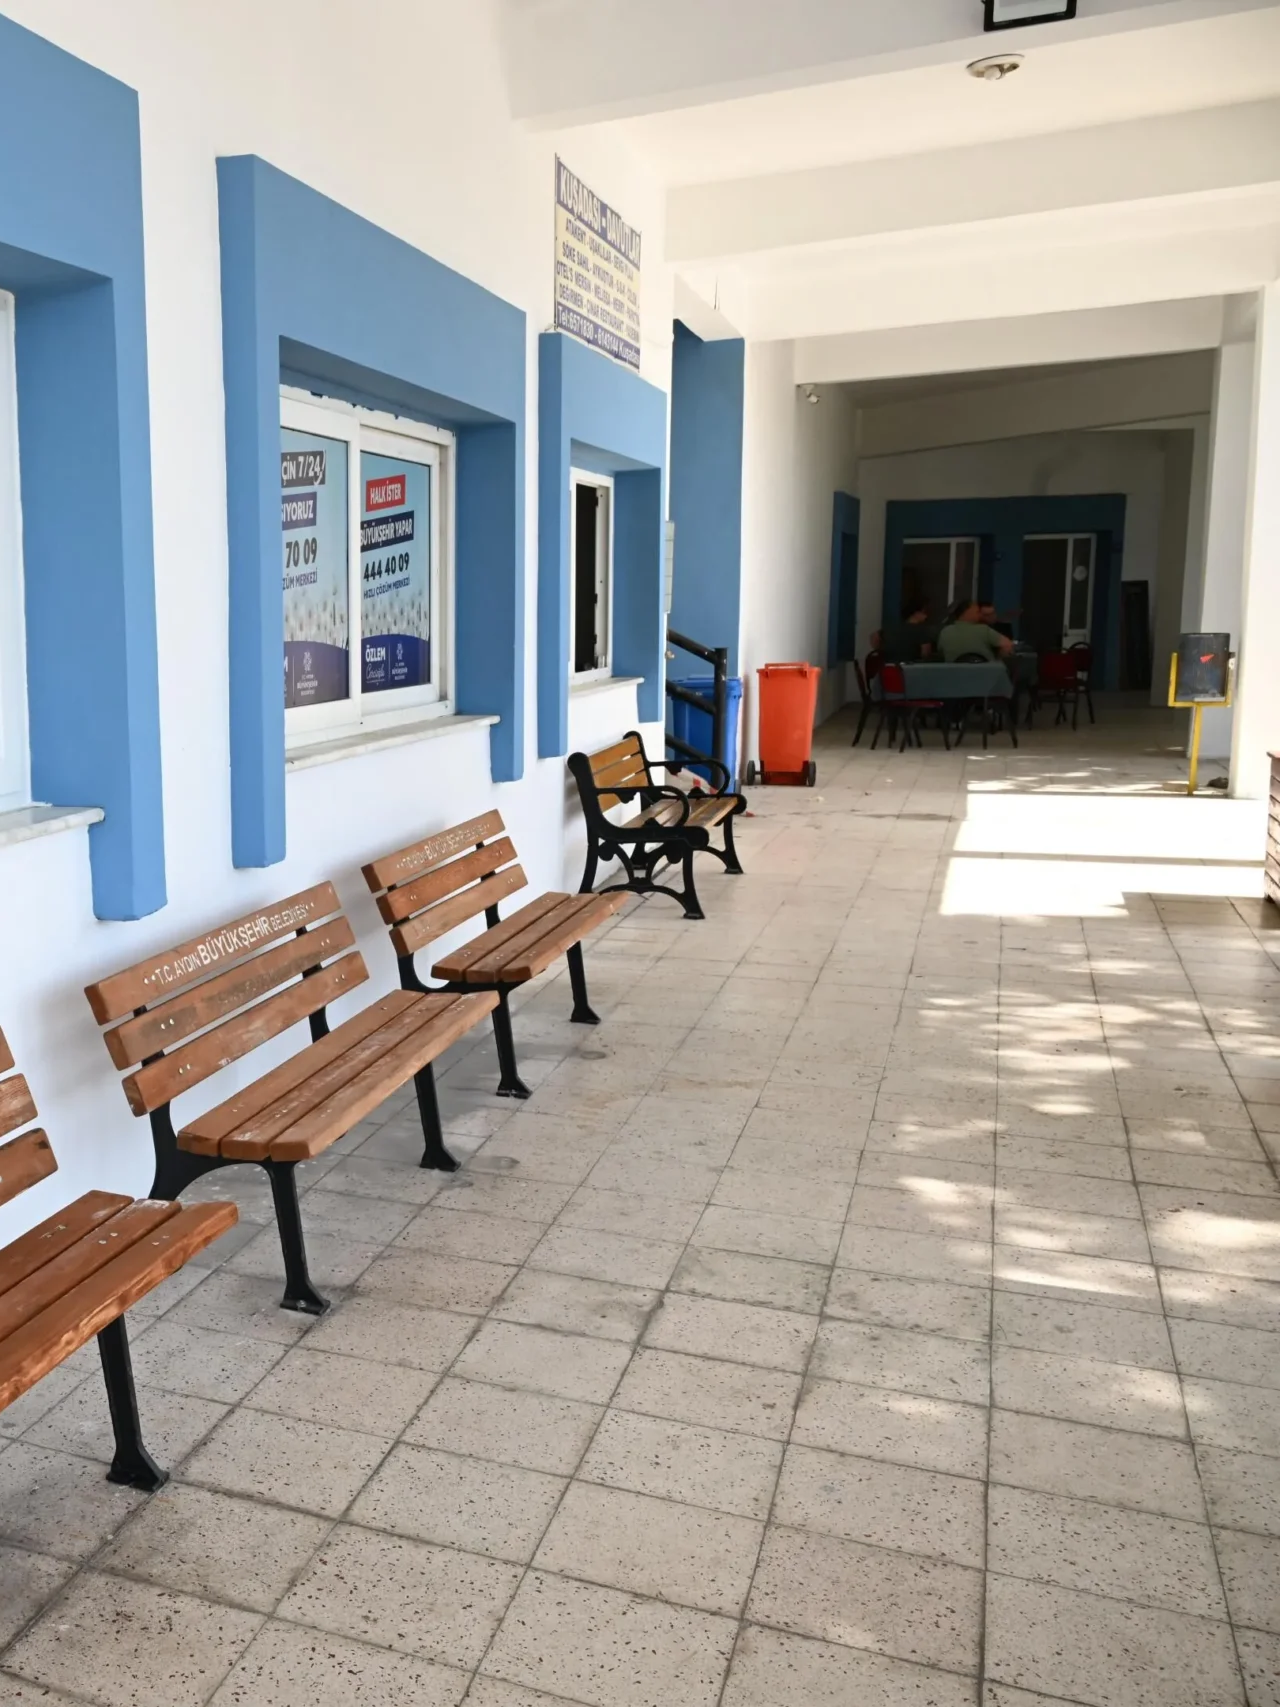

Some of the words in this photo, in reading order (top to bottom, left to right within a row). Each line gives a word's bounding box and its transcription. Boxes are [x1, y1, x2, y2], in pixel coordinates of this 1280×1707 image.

[561, 166, 601, 233] KUŞADASI
[606, 207, 640, 265] DAVUTLAR
[562, 240, 576, 263] SÖKE
[298, 455, 323, 478] 7/24
[370, 485, 386, 505] HALK
[386, 480, 402, 502] İSTER
[360, 518, 395, 546] BÜYÜKŞEHİR
[395, 518, 413, 538] YAPAR
[285, 540, 300, 568] 70
[303, 537, 318, 565] 09
[295, 568, 318, 588] MERKEZİ
[363, 560, 383, 582] 444
[384, 555, 397, 576] 40
[398, 551, 410, 573] 09
[365, 644, 386, 662] ÖZLEM
[175, 953, 202, 978] AYDIN
[197, 915, 274, 965] BÜYÜKŞEHİR
[271, 903, 309, 931] BELEDİYESİ
